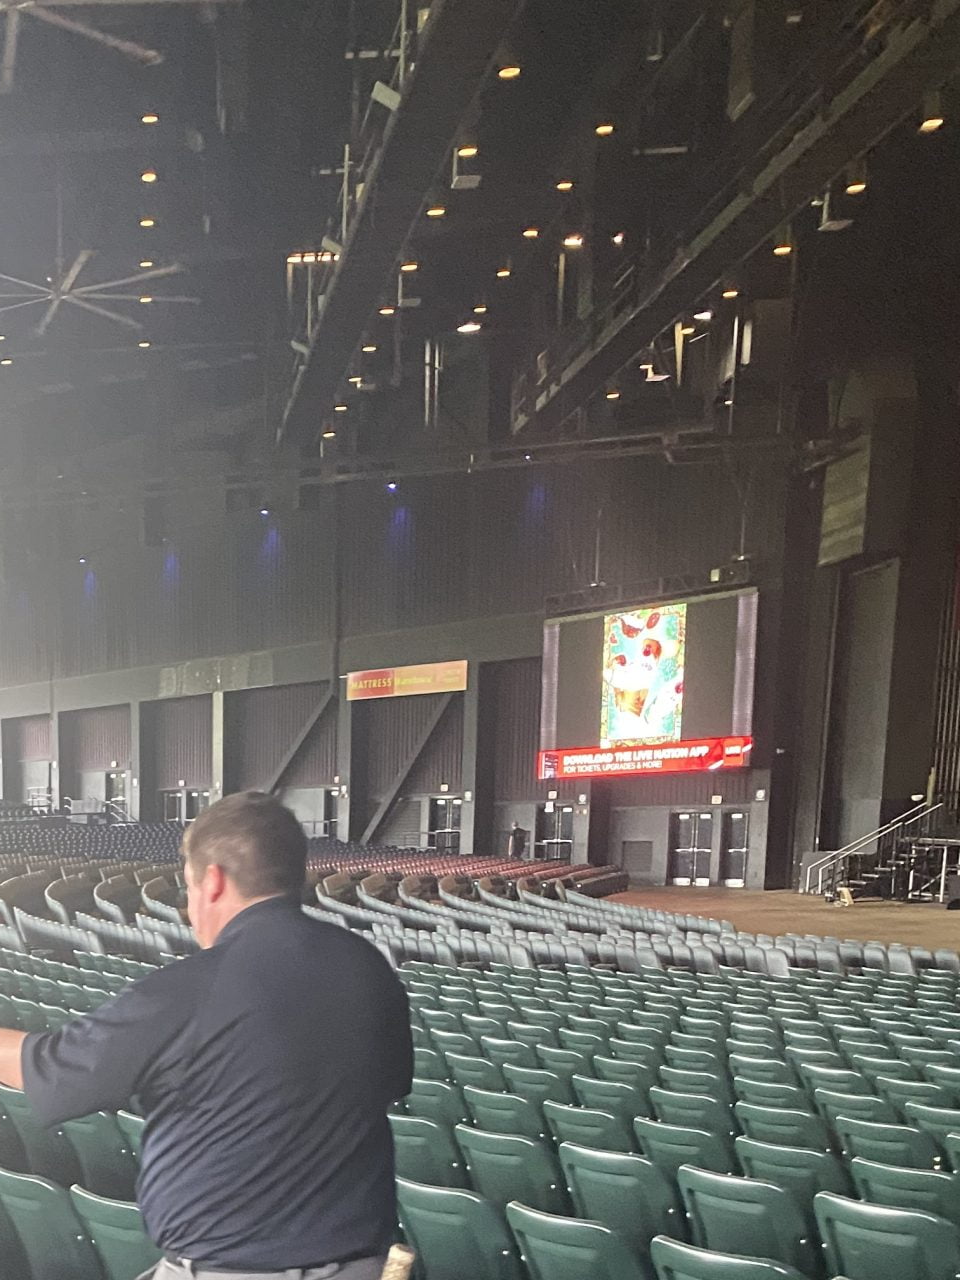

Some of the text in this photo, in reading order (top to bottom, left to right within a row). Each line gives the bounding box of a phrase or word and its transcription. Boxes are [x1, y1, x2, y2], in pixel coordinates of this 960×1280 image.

[351, 678, 392, 690] MATTRESS
[563, 745, 709, 766] DOWNLOAD THE LIVE NATION APP
[563, 765, 576, 774] FOR
[602, 761, 636, 771] UPGRADES
[642, 760, 663, 769] MORE!
